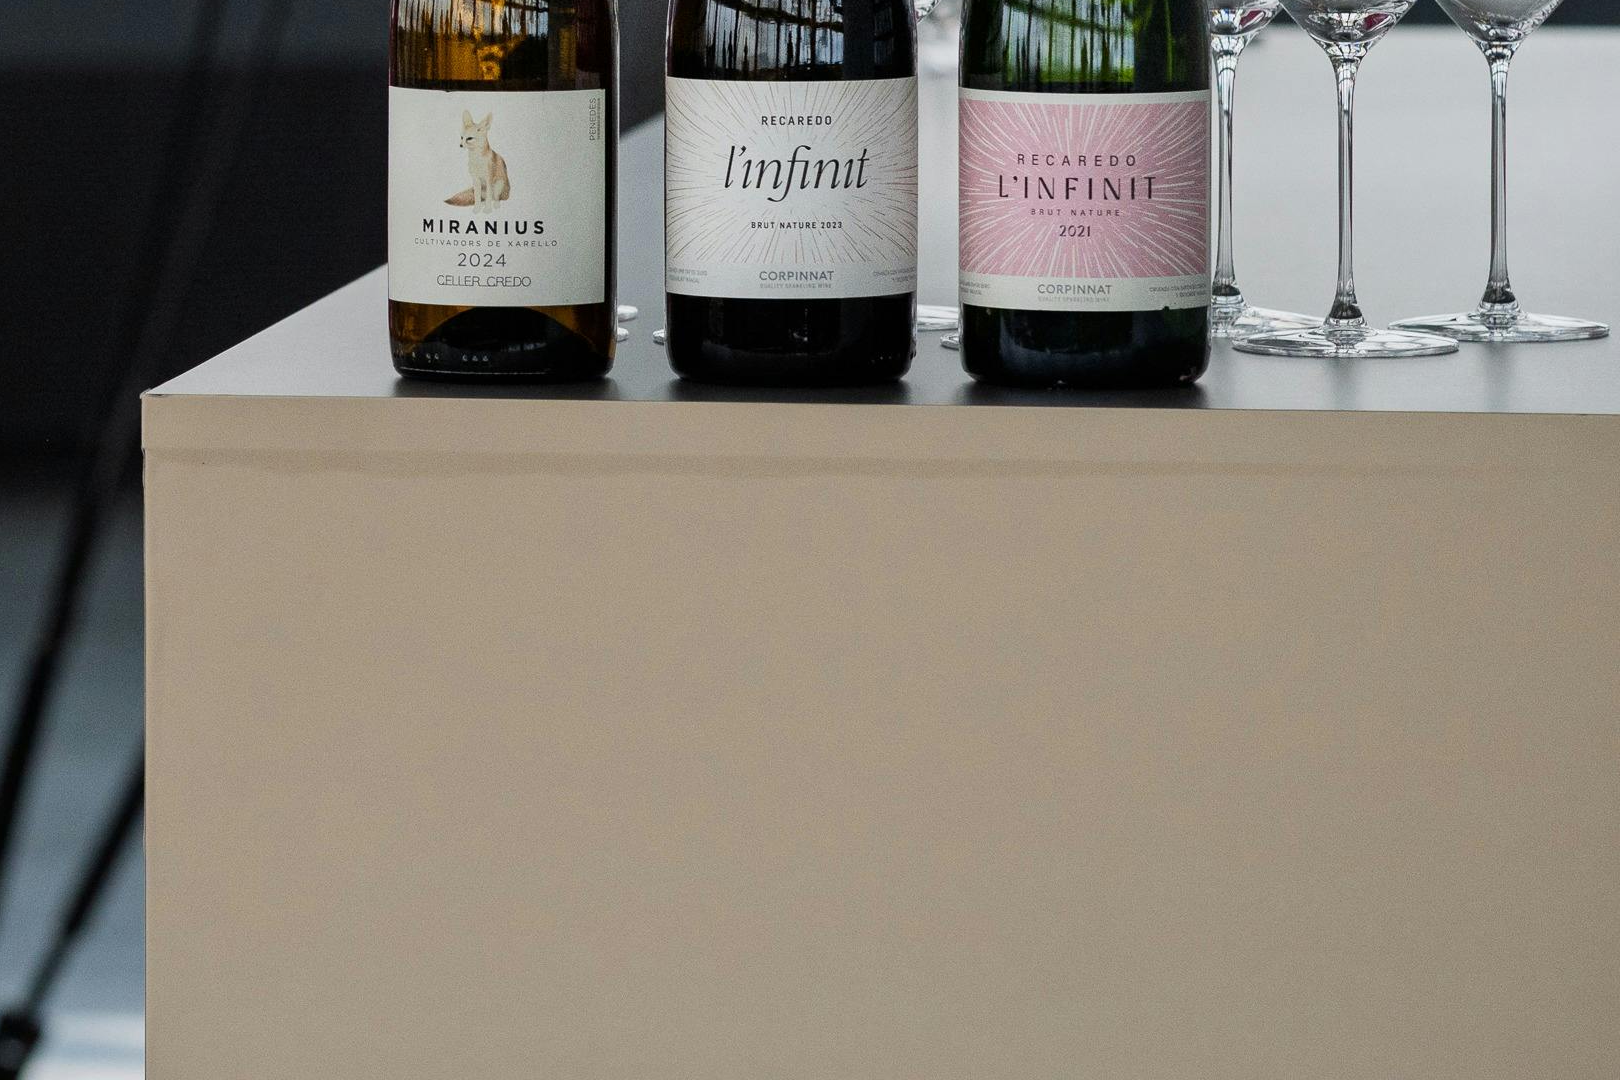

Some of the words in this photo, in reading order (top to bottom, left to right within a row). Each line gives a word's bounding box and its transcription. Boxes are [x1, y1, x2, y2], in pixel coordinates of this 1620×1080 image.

[761, 115, 833, 126] RECAREDO
[1017, 153, 1136, 167] RECAREDO
[998, 174, 1157, 201] L'INFINIT
[1030, 208, 1061, 216] BRUT
[1070, 209, 1120, 217] NATURE
[422, 218, 545, 235] MIRANIUS
[751, 221, 776, 229] BRUT
[779, 222, 817, 230] NATURE
[1059, 224, 1091, 238] 2021
[414, 237, 482, 247] CULTIVADORS
[487, 240, 501, 248] DE
[457, 252, 507, 268] 2024
[759, 270, 835, 281] CORPINNAT
[1037, 283, 1113, 295] CORPINNAT
